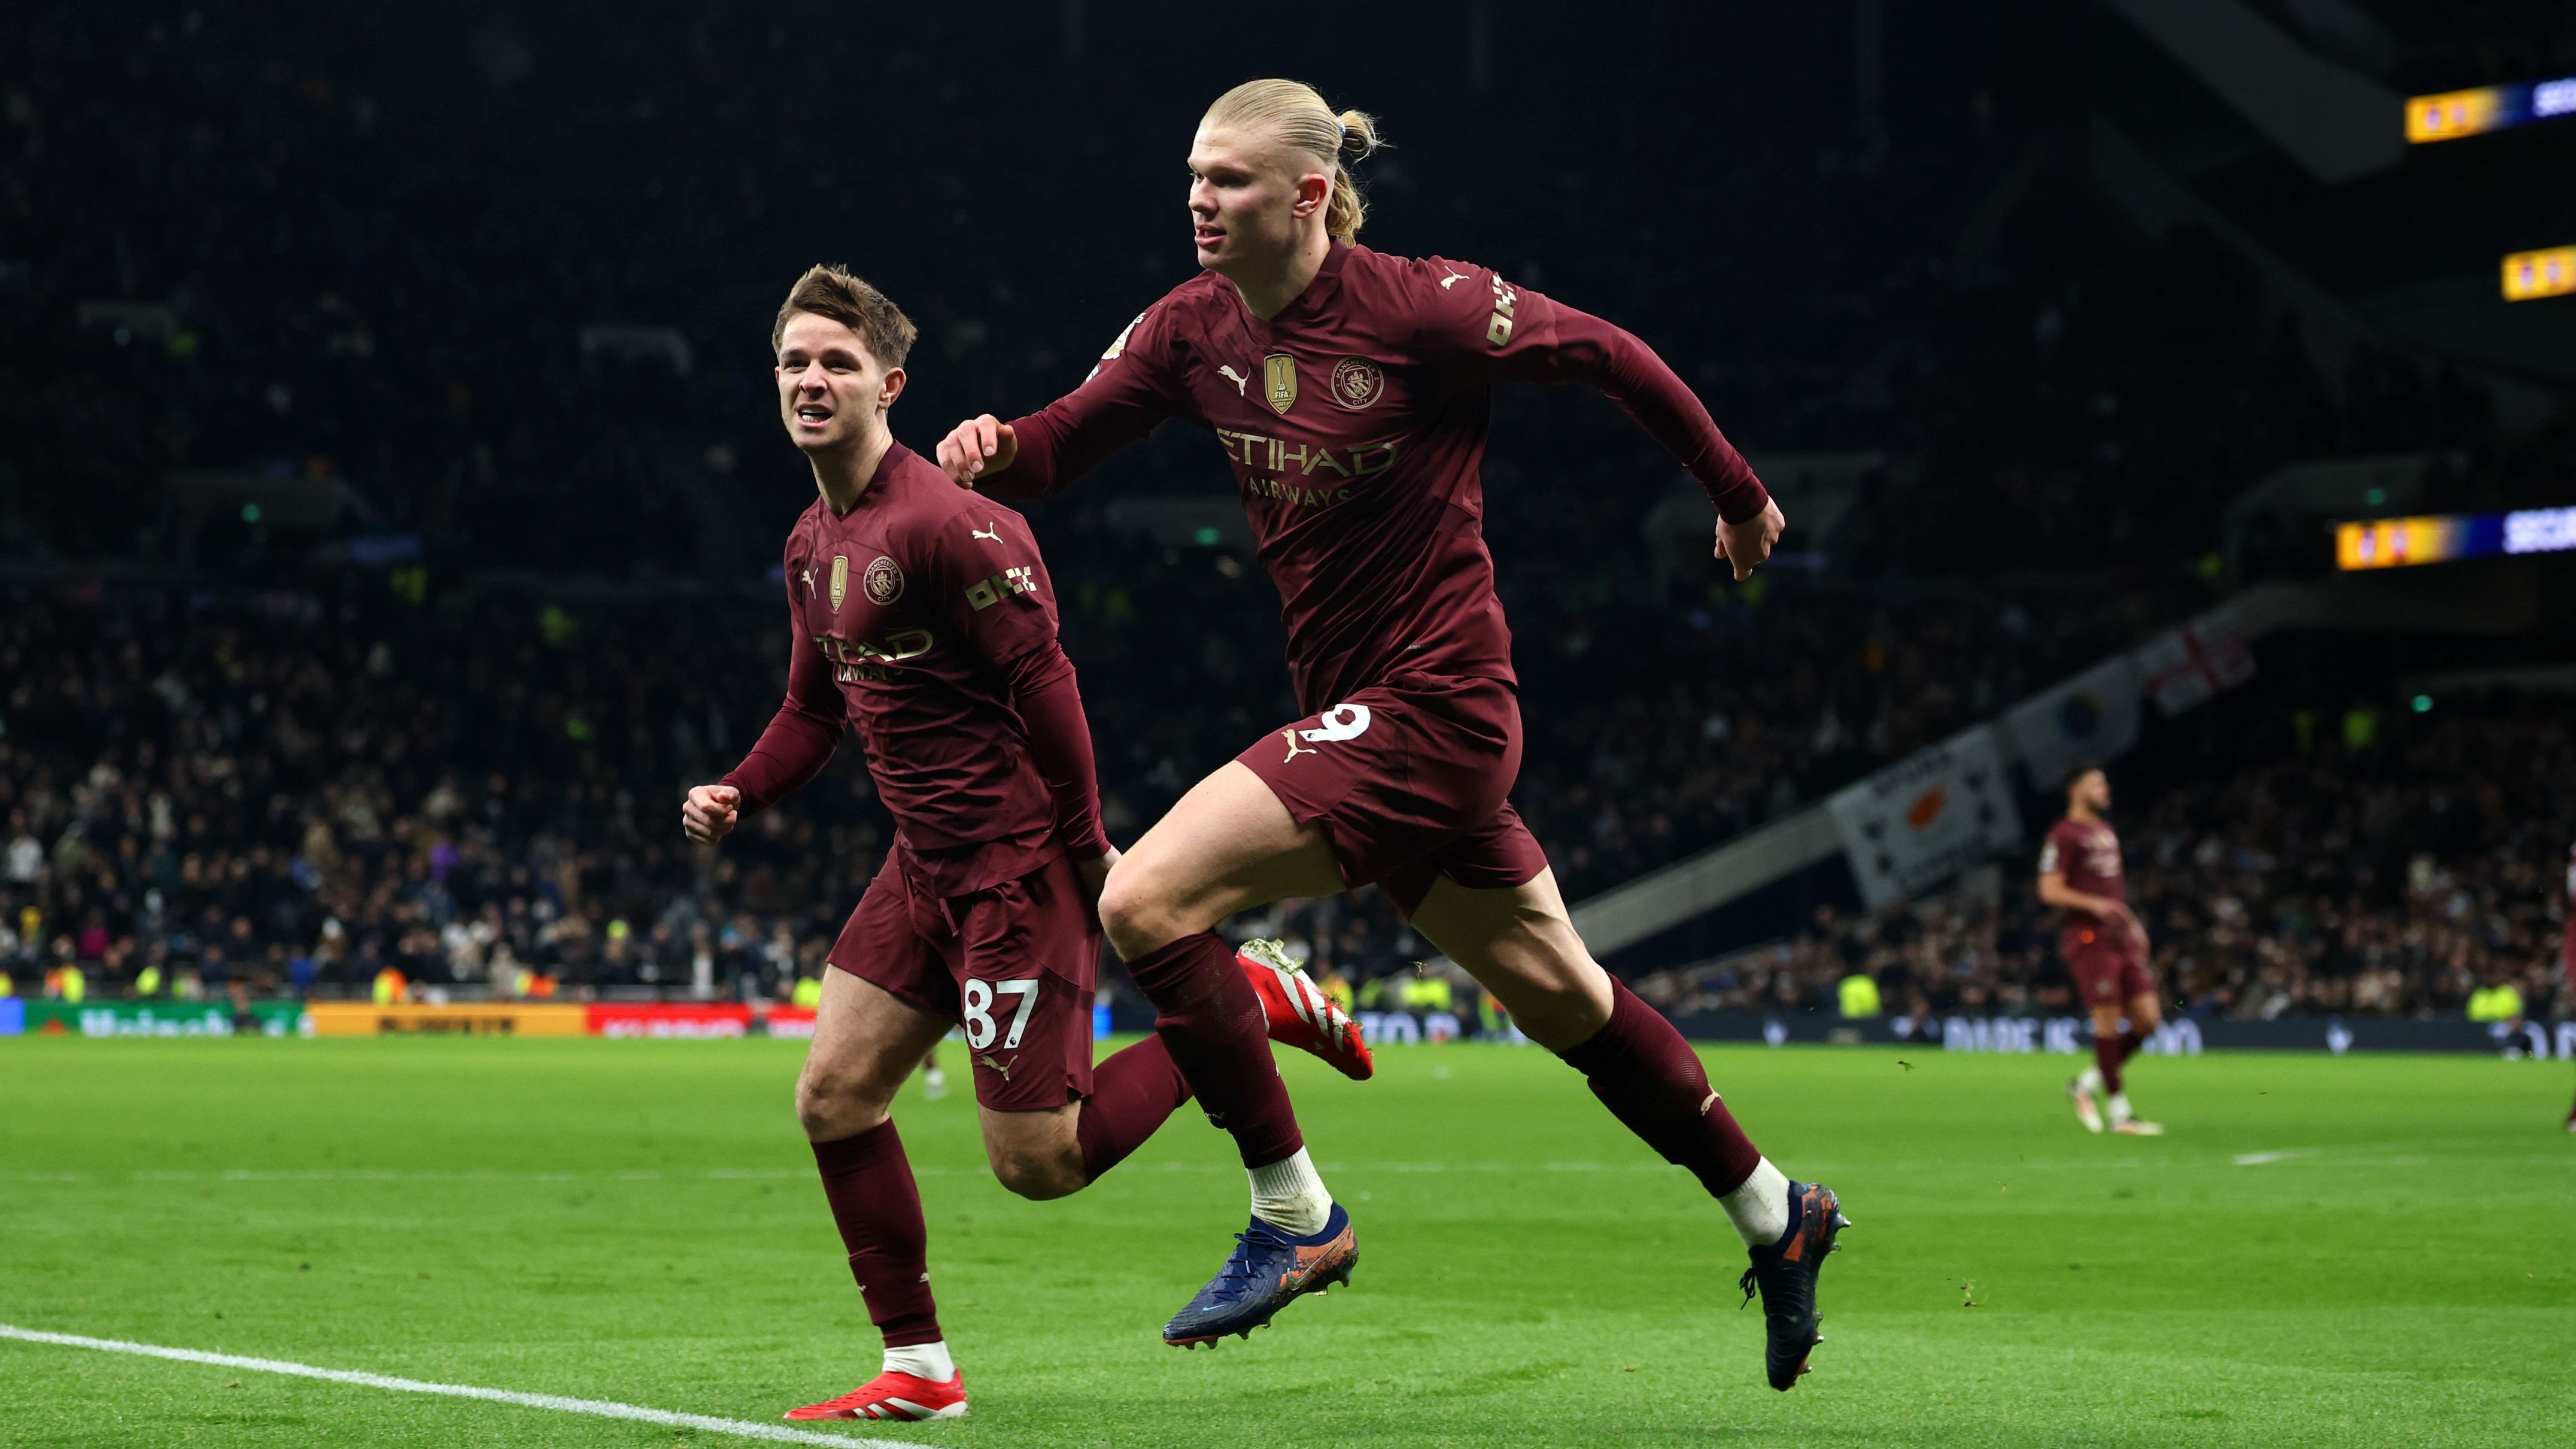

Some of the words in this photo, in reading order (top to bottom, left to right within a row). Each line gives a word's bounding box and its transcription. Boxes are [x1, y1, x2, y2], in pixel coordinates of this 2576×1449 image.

[1216, 427, 1398, 478] ETIHAD
[1249, 476, 1350, 506] AIRWAYS
[868, 560, 898, 576] MANCHESTER
[1298, 703, 1371, 742] 9
[964, 979, 1039, 1049] 87
